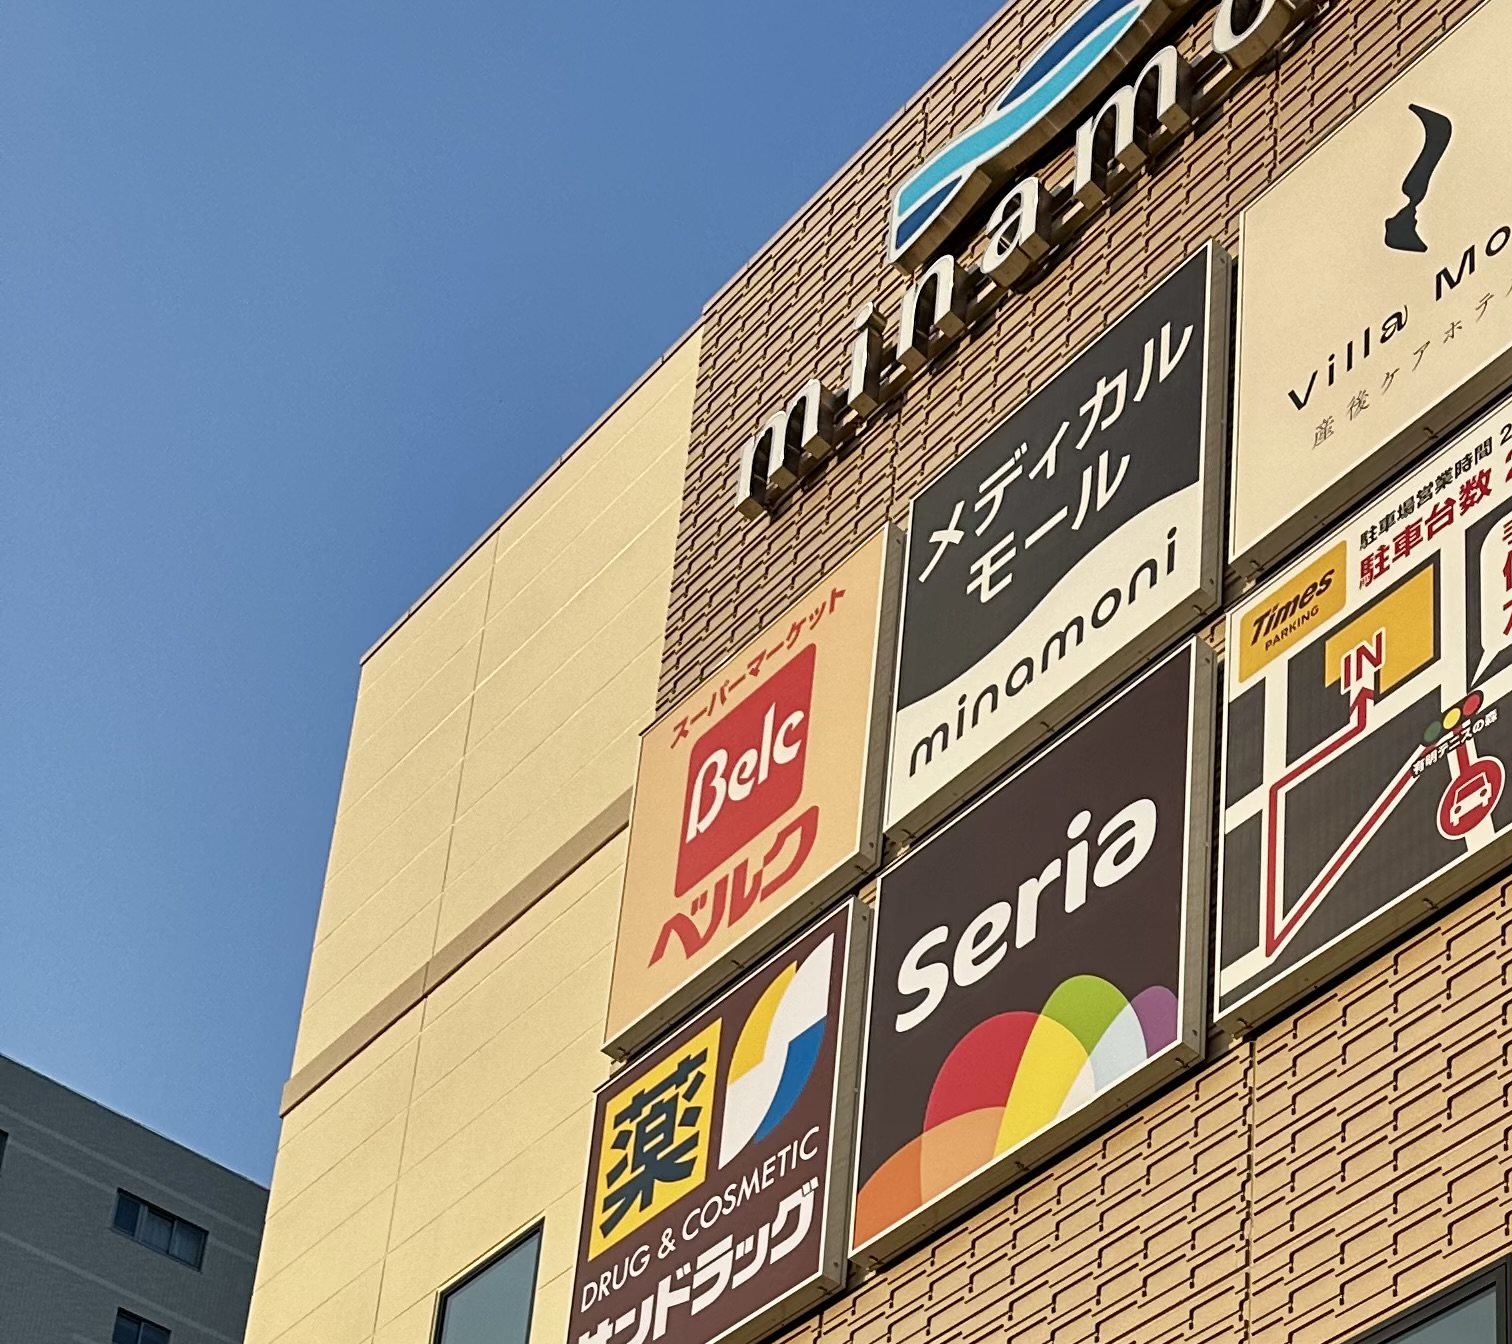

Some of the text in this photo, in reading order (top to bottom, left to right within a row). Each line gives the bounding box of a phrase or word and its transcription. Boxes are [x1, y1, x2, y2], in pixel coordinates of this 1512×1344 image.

[1287, 302, 1410, 411] Villa
[919, 322, 1193, 583] メディカル
[1359, 436, 1492, 550] 駐車場営業時間
[967, 451, 1130, 606] モール
[1359, 466, 1492, 589] 駐車台数
[671, 586, 847, 750] スーパーマーケット
[910, 527, 1177, 779] minamoni
[1250, 563, 1334, 650] Times
[1265, 603, 1320, 651] PARKING
[1343, 634, 1384, 688] IN
[686, 702, 806, 843] Belc
[1412, 709, 1498, 777] 有明テニスの森
[647, 804, 820, 968] ベルク
[895, 797, 1159, 1033] Seria
[600, 1047, 708, 1239] 薬
[580, 1126, 820, 1311] DRUG & COSMETIC
